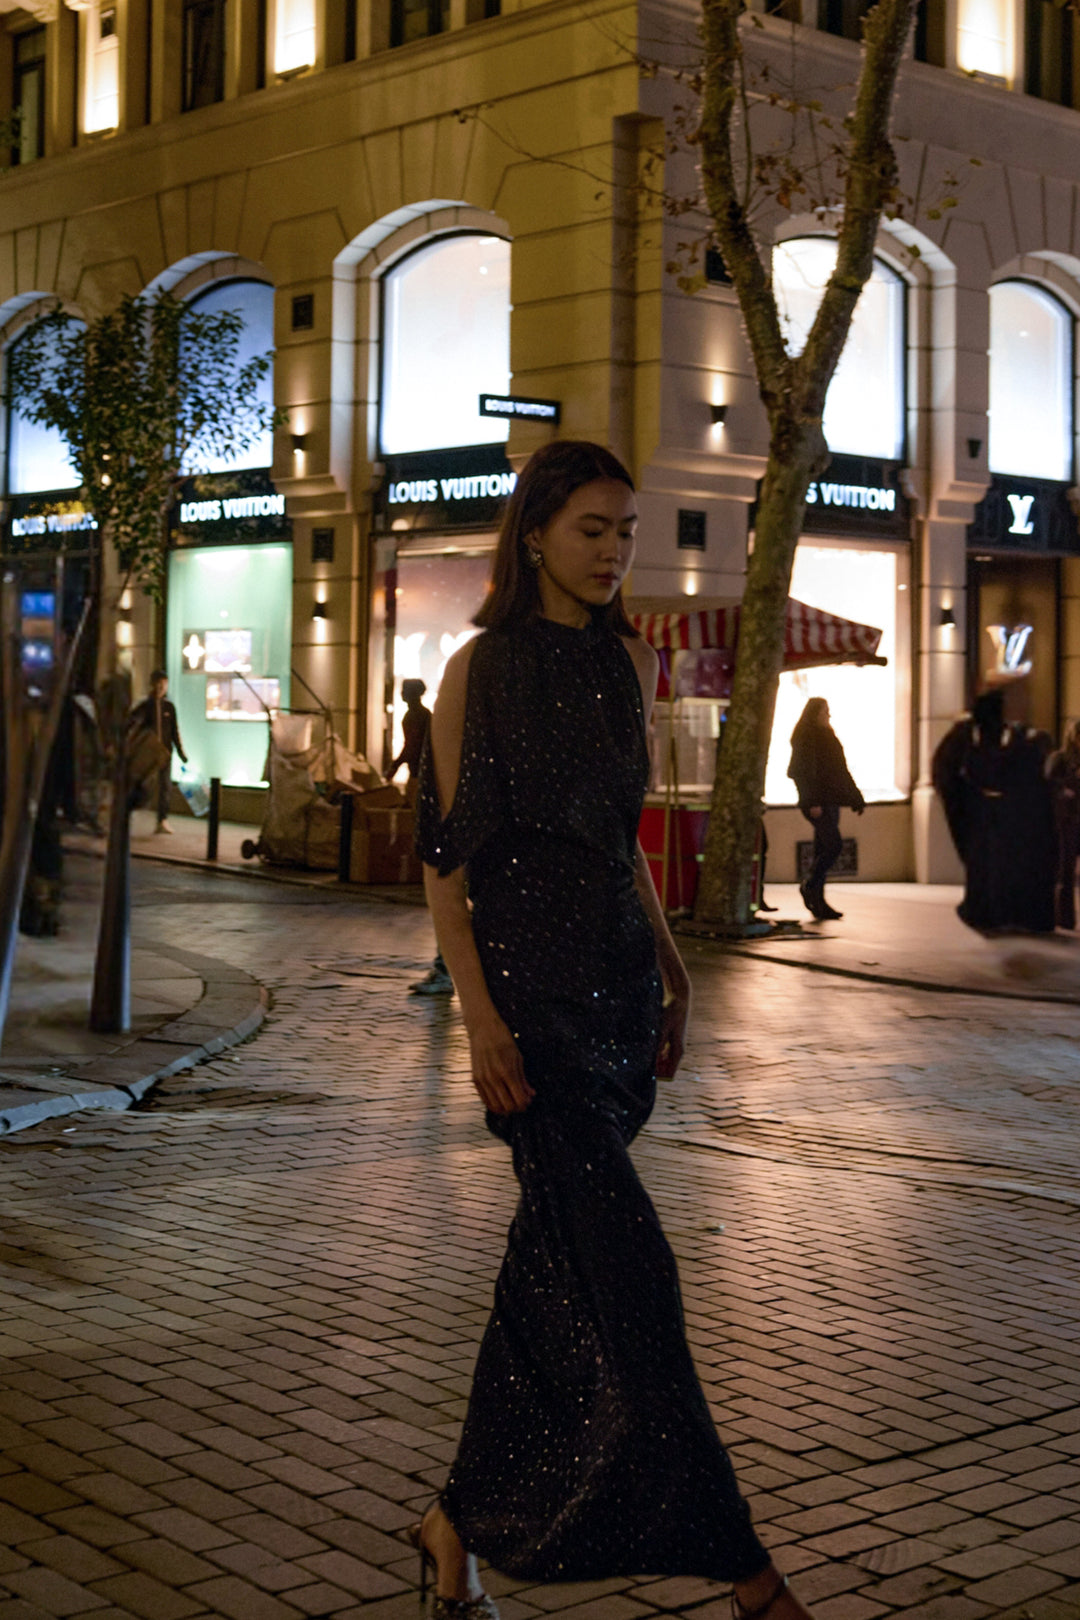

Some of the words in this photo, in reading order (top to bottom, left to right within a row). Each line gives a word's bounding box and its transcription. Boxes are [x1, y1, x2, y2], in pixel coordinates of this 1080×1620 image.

[485, 399, 514, 413] LOUIS
[389, 479, 438, 503] LOUIS
[440, 472, 518, 500] VUITTON
[820, 482, 895, 511] VUITTON
[180, 500, 221, 523] LOUIS
[222, 494, 285, 519] VUITTON
